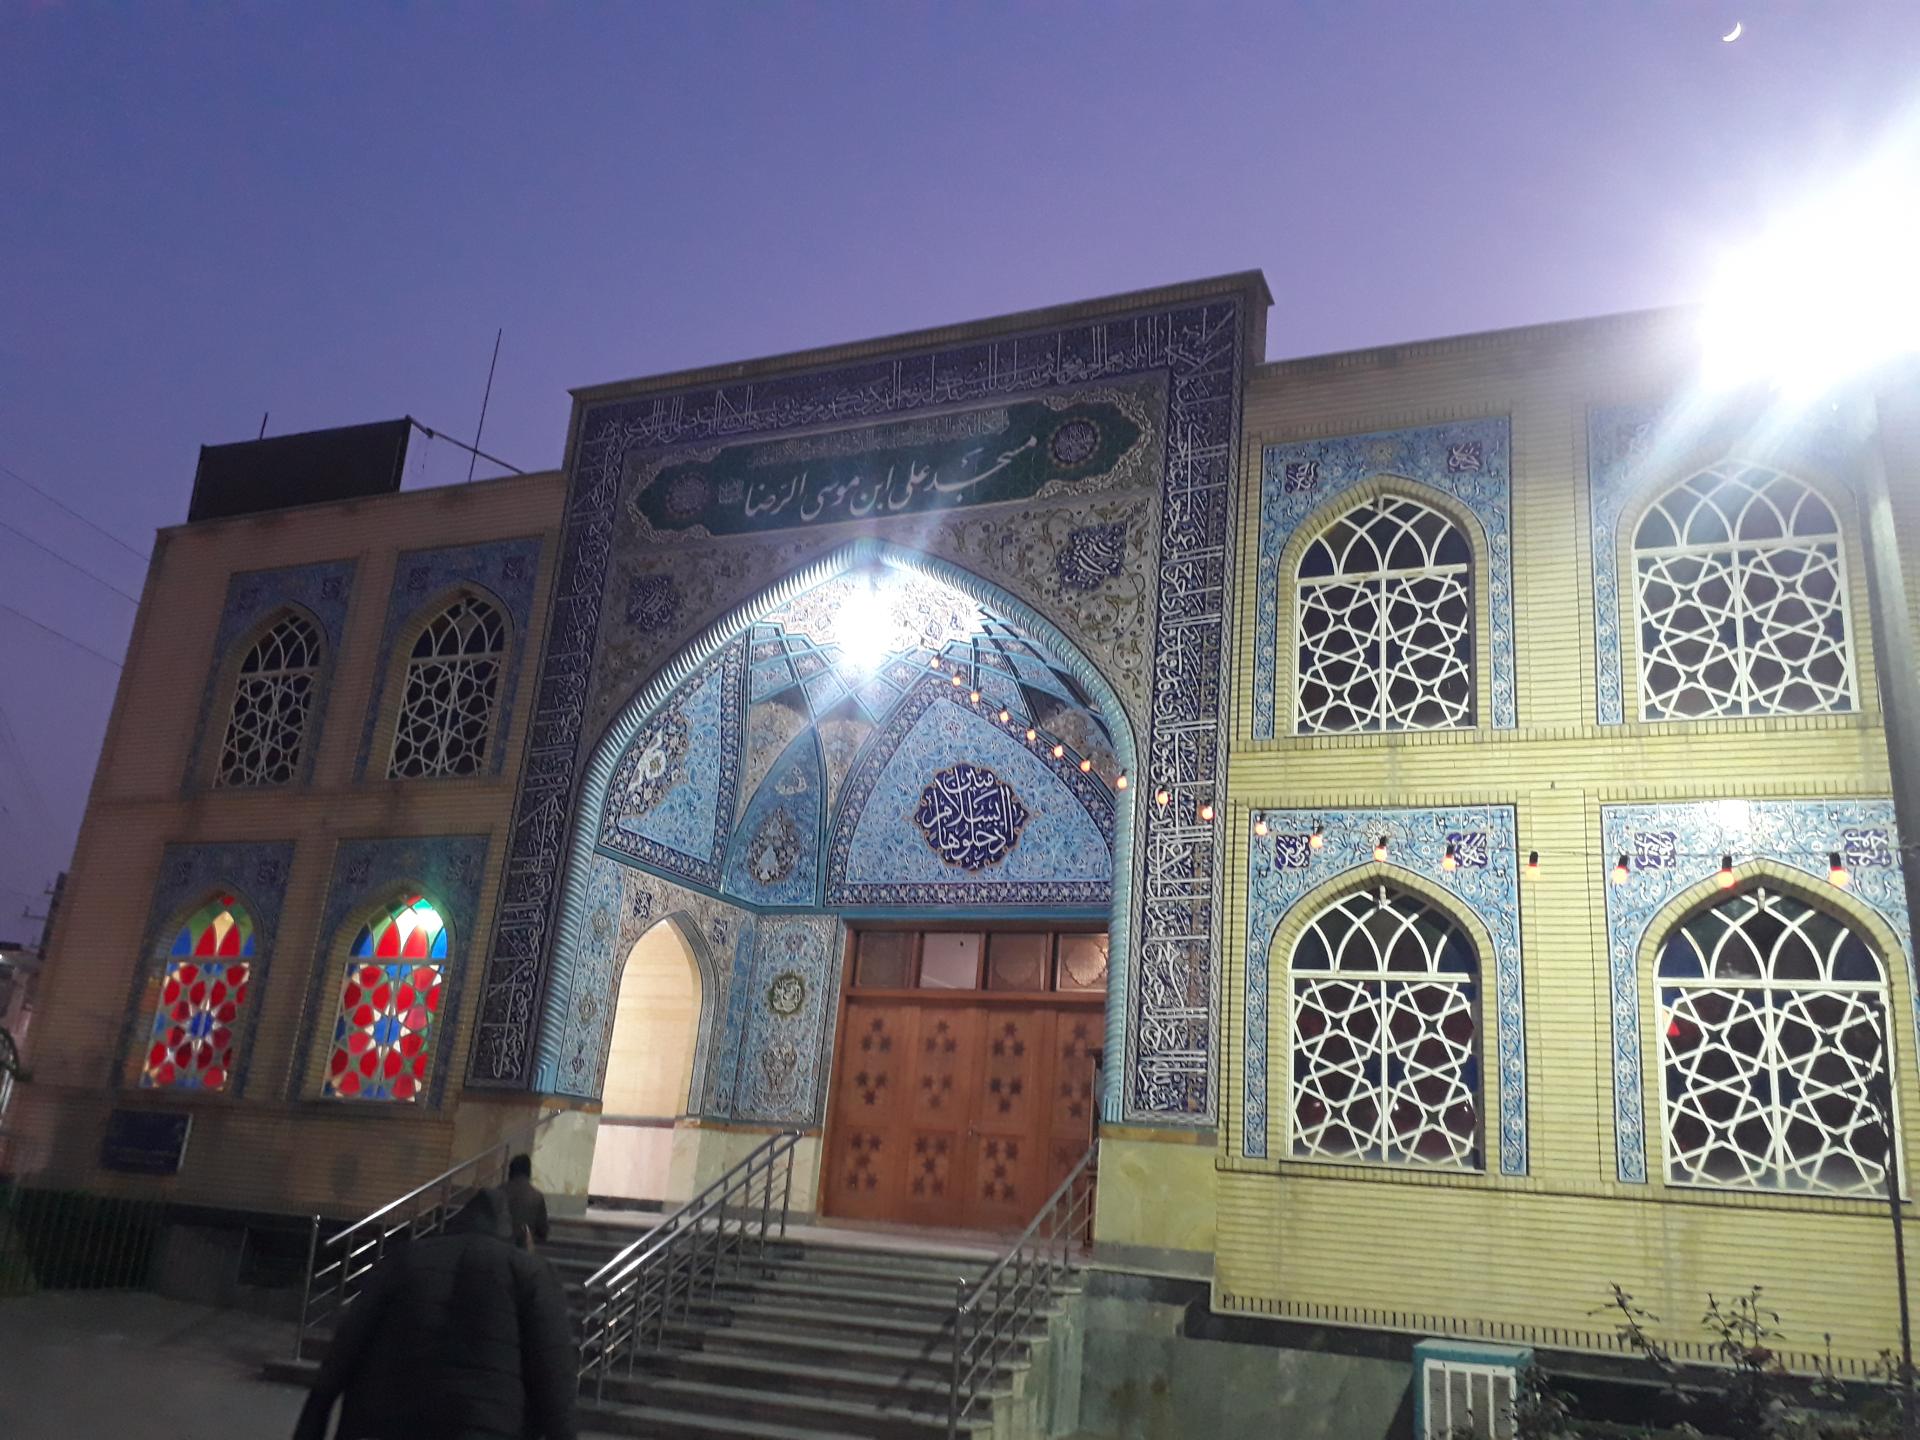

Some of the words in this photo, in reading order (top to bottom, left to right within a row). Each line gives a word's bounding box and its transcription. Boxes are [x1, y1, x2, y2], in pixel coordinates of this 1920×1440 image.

[745, 469, 808, 517] الرضا
[850, 464, 896, 517] ابن
[923, 434, 1037, 503] مسجد
